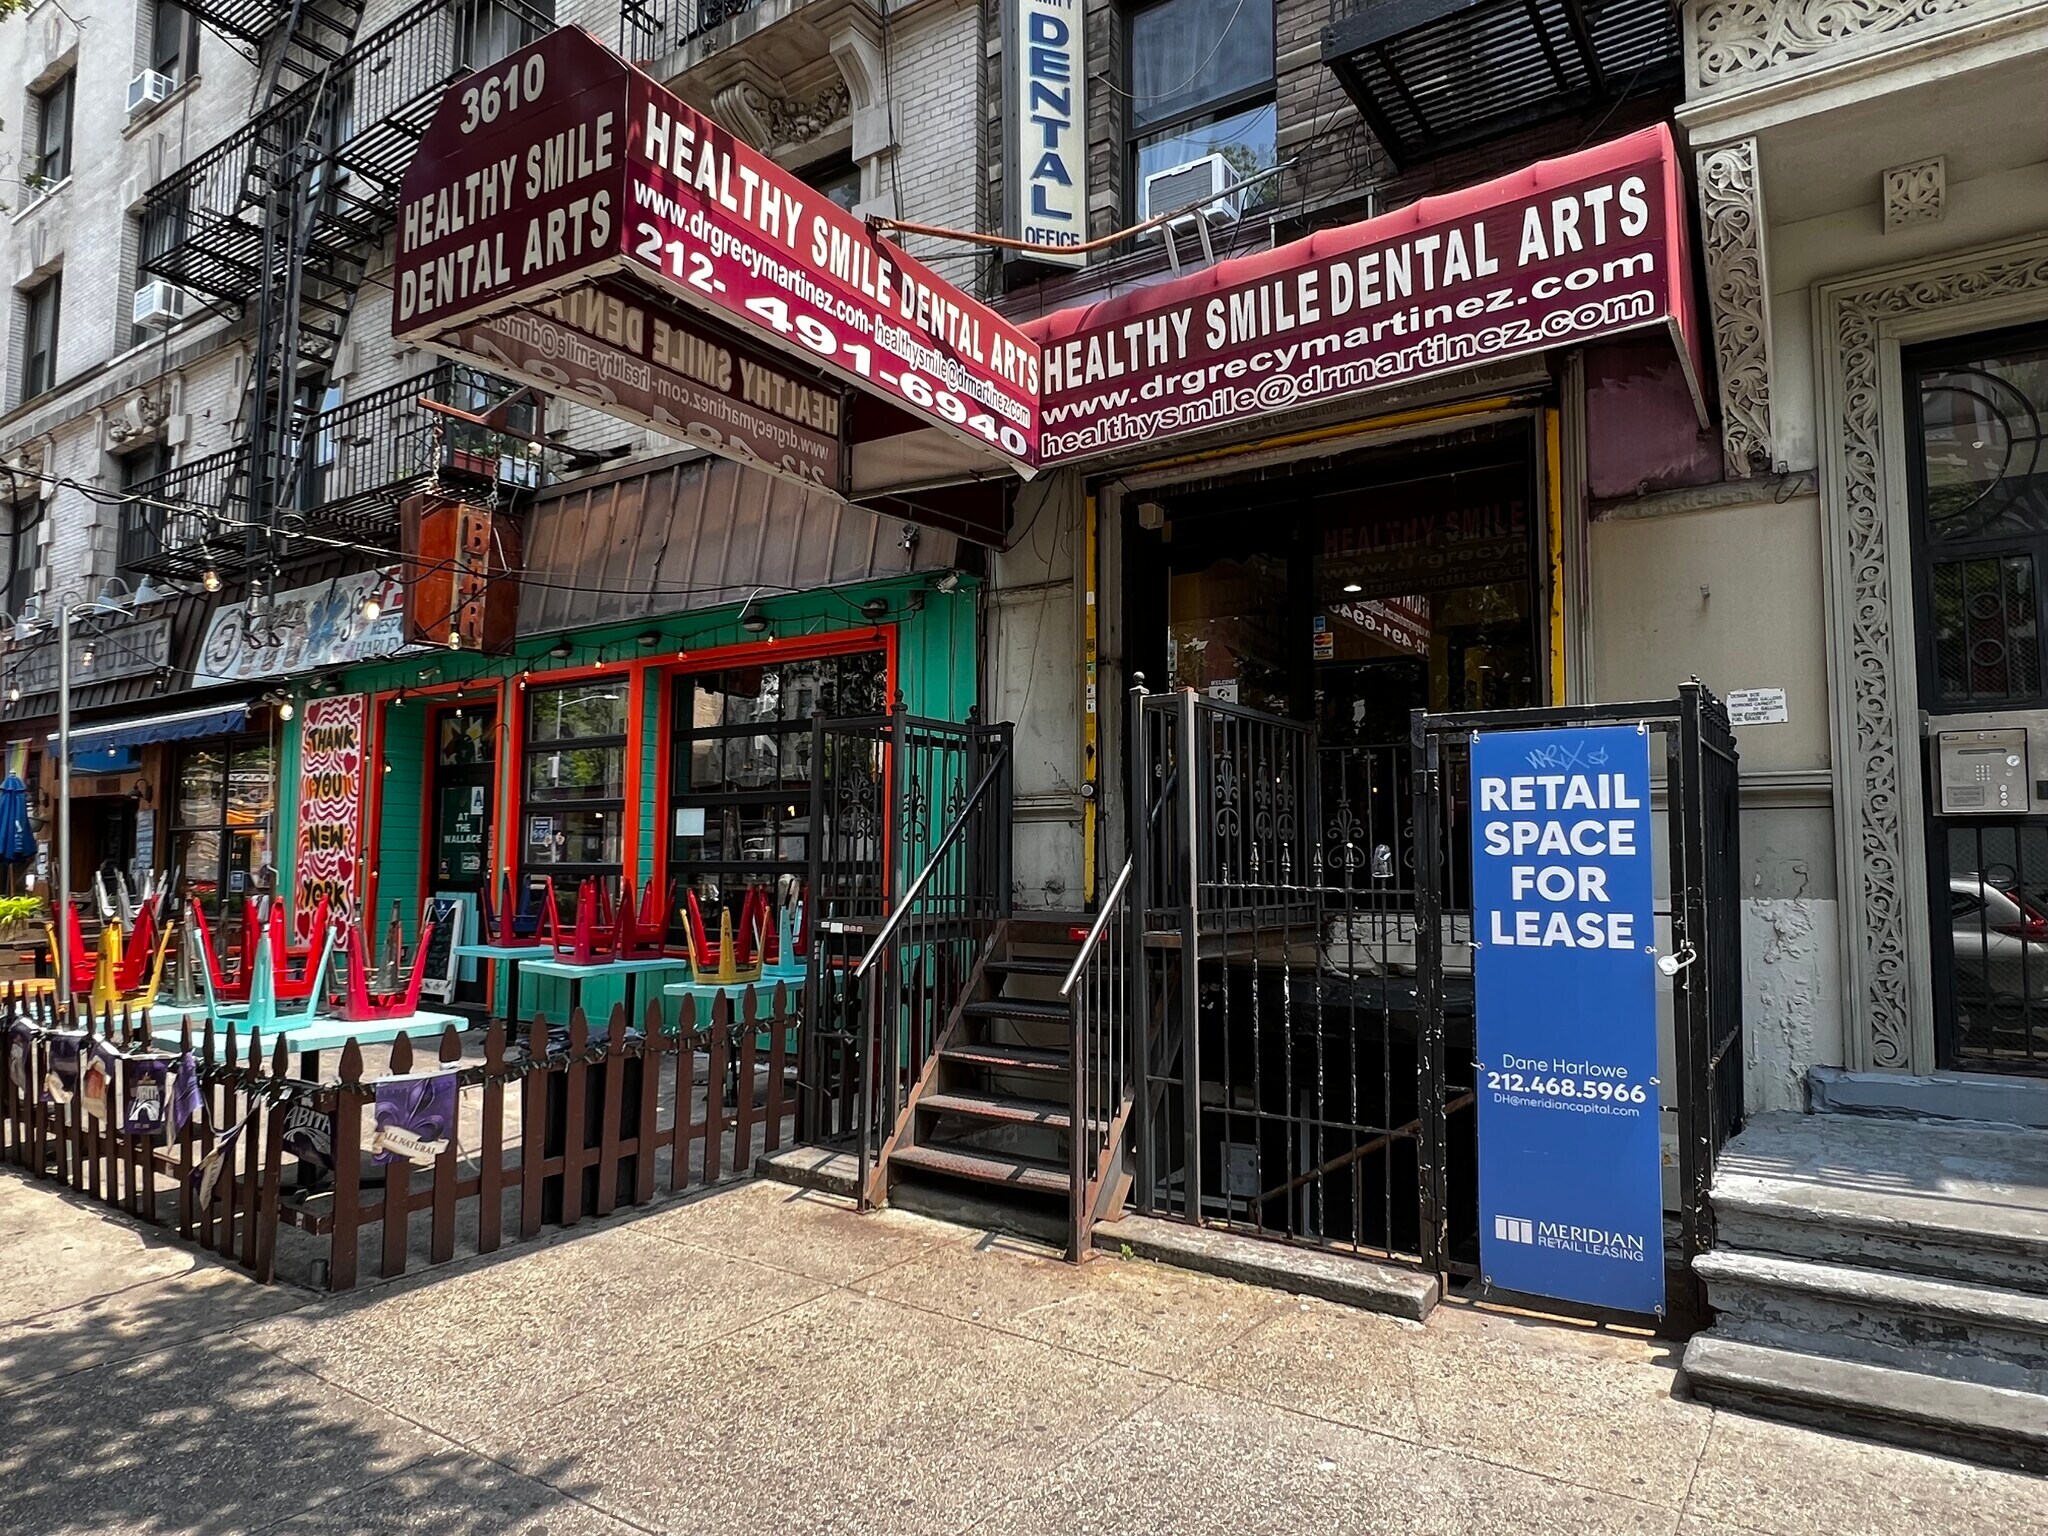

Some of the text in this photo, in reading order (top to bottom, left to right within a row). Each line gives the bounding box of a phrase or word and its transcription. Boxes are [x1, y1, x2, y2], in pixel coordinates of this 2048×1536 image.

[461, 54, 545, 134] 3610
[1029, 11, 1073, 221] DENTAL
[403, 111, 613, 253] HEALTHY SMILE
[645, 102, 1040, 396] HEALTHY SMILE DENTAL ARTS
[1025, 226, 1080, 247] OFFICE
[400, 190, 611, 321] DENTAL ARTS
[1044, 176, 1649, 395] HEALTHY SMILE DENTAL ARTS
[635, 222, 1028, 456] 212- 491-6940
[1041, 252, 1655, 425] www.drgrecymartinez.com
[1041, 289, 1655, 458] healthysmile@drmartinez.com
[309, 725, 355, 753] THANK
[312, 772, 343, 799] YOU
[1480, 774, 1640, 811] RETAIL
[455, 823, 471, 832] THE
[457, 812, 469, 821] AT
[309, 824, 344, 851] NEW
[443, 834, 482, 843] WALLACE
[1484, 820, 1636, 856] SPACE
[303, 879, 348, 916] YORK
[1512, 866, 1611, 902] FOR
[1490, 910, 1635, 949] LEASE
[1502, 1053, 1628, 1079] Dane Harlowe
[1487, 1071, 1647, 1103] 212.468.5966
[1493, 1092, 1640, 1118] DH@meridiancapital.com
[284, 1105, 331, 1135] ABITA
[1538, 1221, 1643, 1250] MERIDIAN
[1538, 1236, 1644, 1262] RETAIL LEASING
